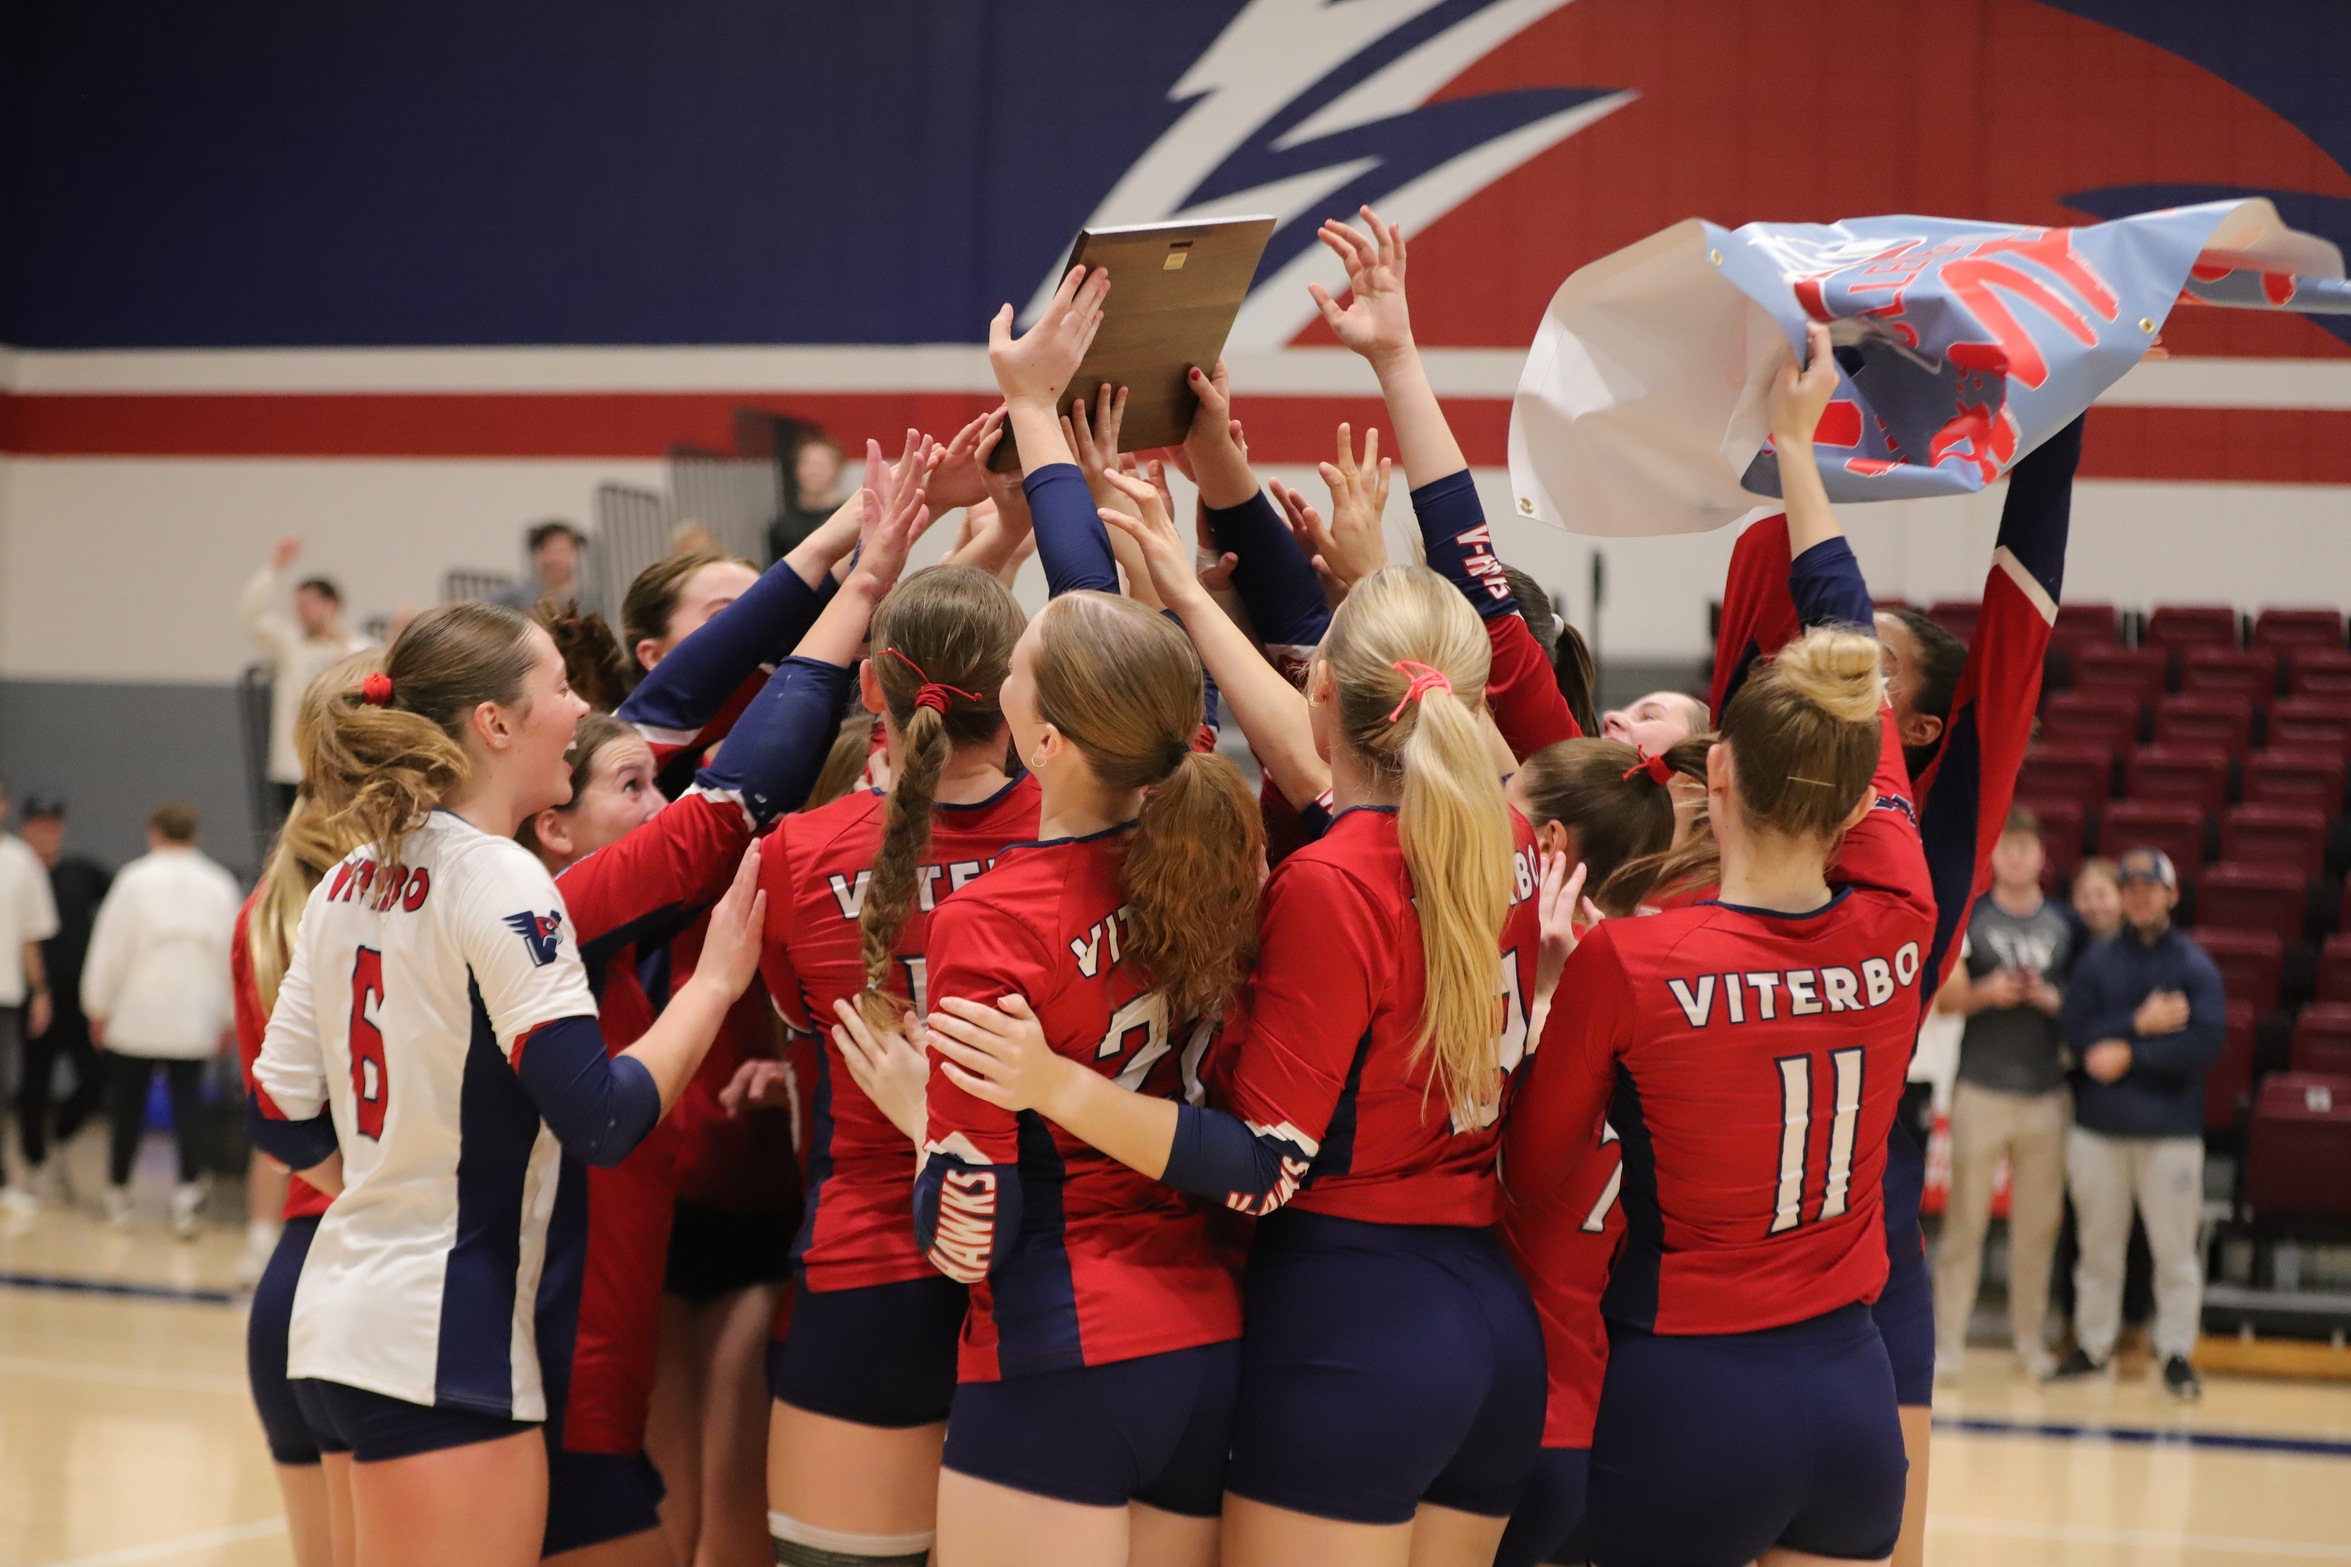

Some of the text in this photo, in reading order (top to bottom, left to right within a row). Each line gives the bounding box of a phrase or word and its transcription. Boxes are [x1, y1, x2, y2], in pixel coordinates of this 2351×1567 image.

[348, 944, 390, 1142] 6
[1666, 940, 1920, 1029] VITERBO
[1766, 1045, 1866, 1239] 11
